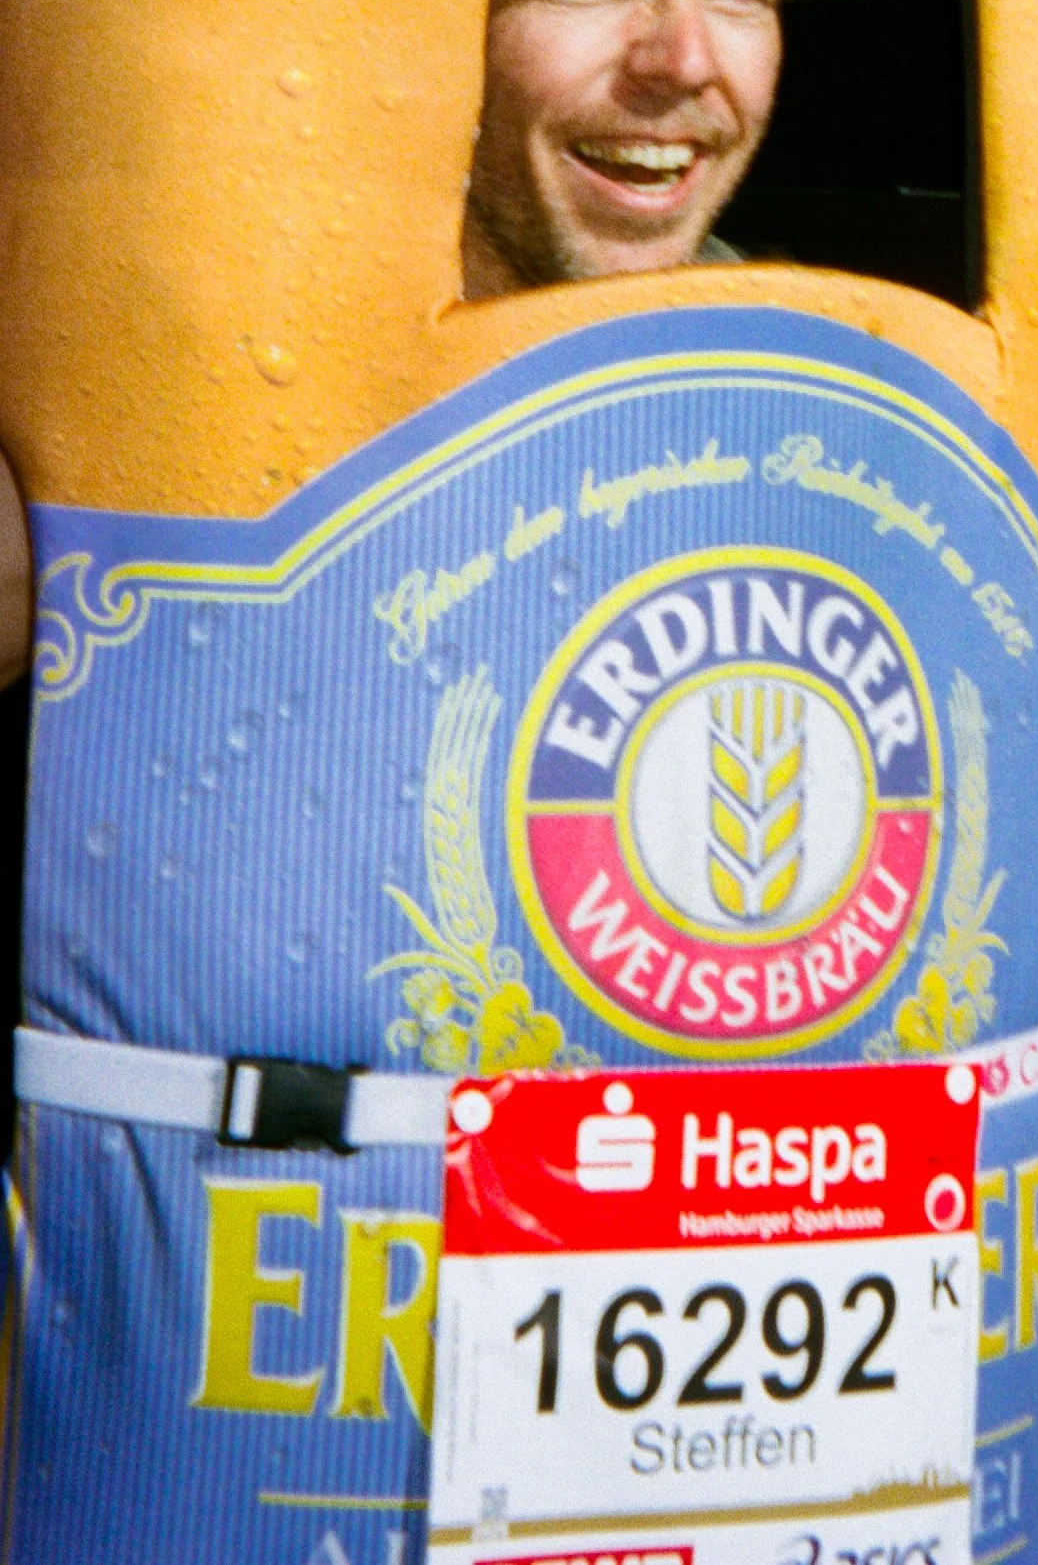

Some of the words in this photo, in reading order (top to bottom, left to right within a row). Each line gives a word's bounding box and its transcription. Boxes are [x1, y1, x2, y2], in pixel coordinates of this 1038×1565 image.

[546, 578, 920, 768] ERDINGER
[566, 864, 910, 1030] WEISSBRÄU
[680, 1110, 888, 1204] Haspa
[679, 1209, 791, 1242] Hamburger
[791, 1204, 885, 1238] Sparkasse
[513, 1272, 898, 1416] 16292
[931, 1255, 960, 1309] K
[629, 1411, 817, 1475] Steffen
